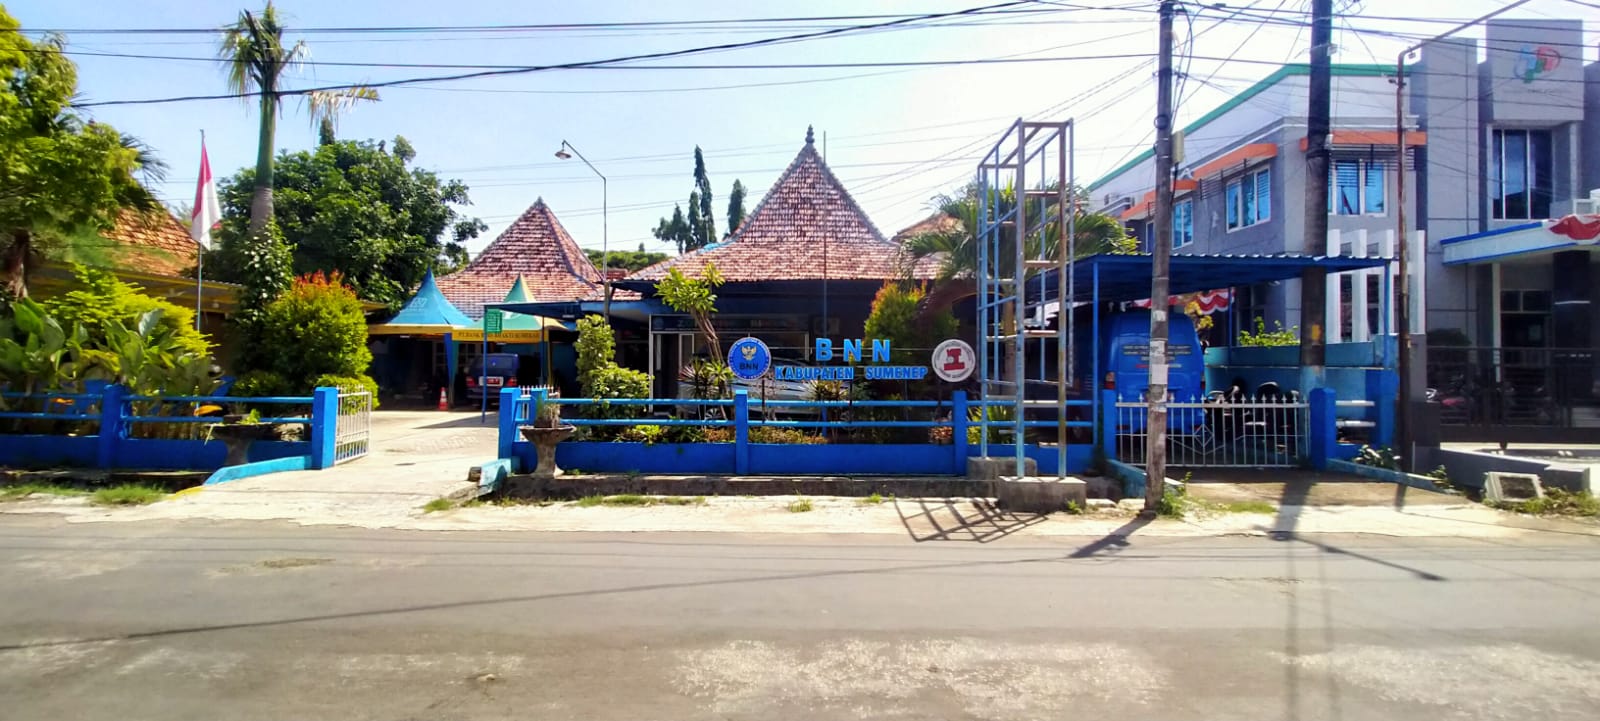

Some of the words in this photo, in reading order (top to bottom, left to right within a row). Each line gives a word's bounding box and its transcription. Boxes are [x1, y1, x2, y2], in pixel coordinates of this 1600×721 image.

[815, 337, 891, 362] BNN
[739, 362, 759, 370] BNN
[774, 366, 854, 380] KABUPATEN
[864, 366, 928, 380] SUMENEP
